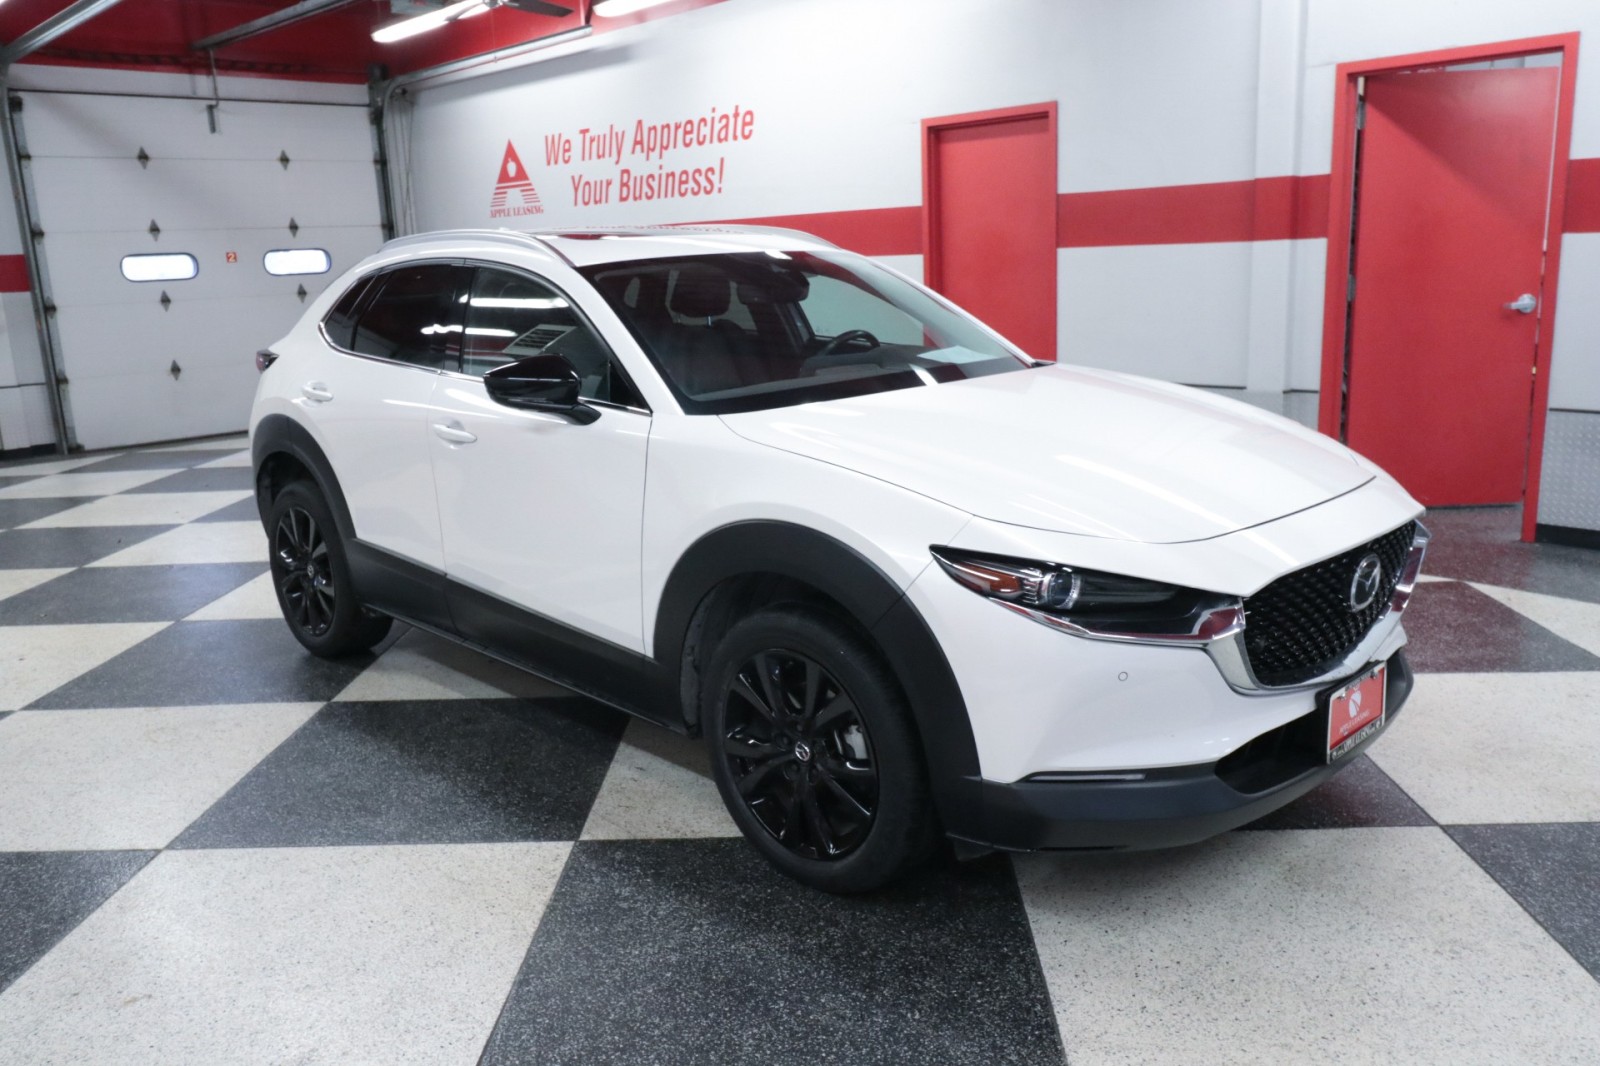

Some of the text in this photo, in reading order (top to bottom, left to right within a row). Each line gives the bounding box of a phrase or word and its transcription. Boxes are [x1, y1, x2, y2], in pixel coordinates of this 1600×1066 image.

[544, 105, 755, 166] We Truly Appreciate
[571, 157, 725, 207] Your Business!
[490, 205, 544, 218] APPLE LEASING
